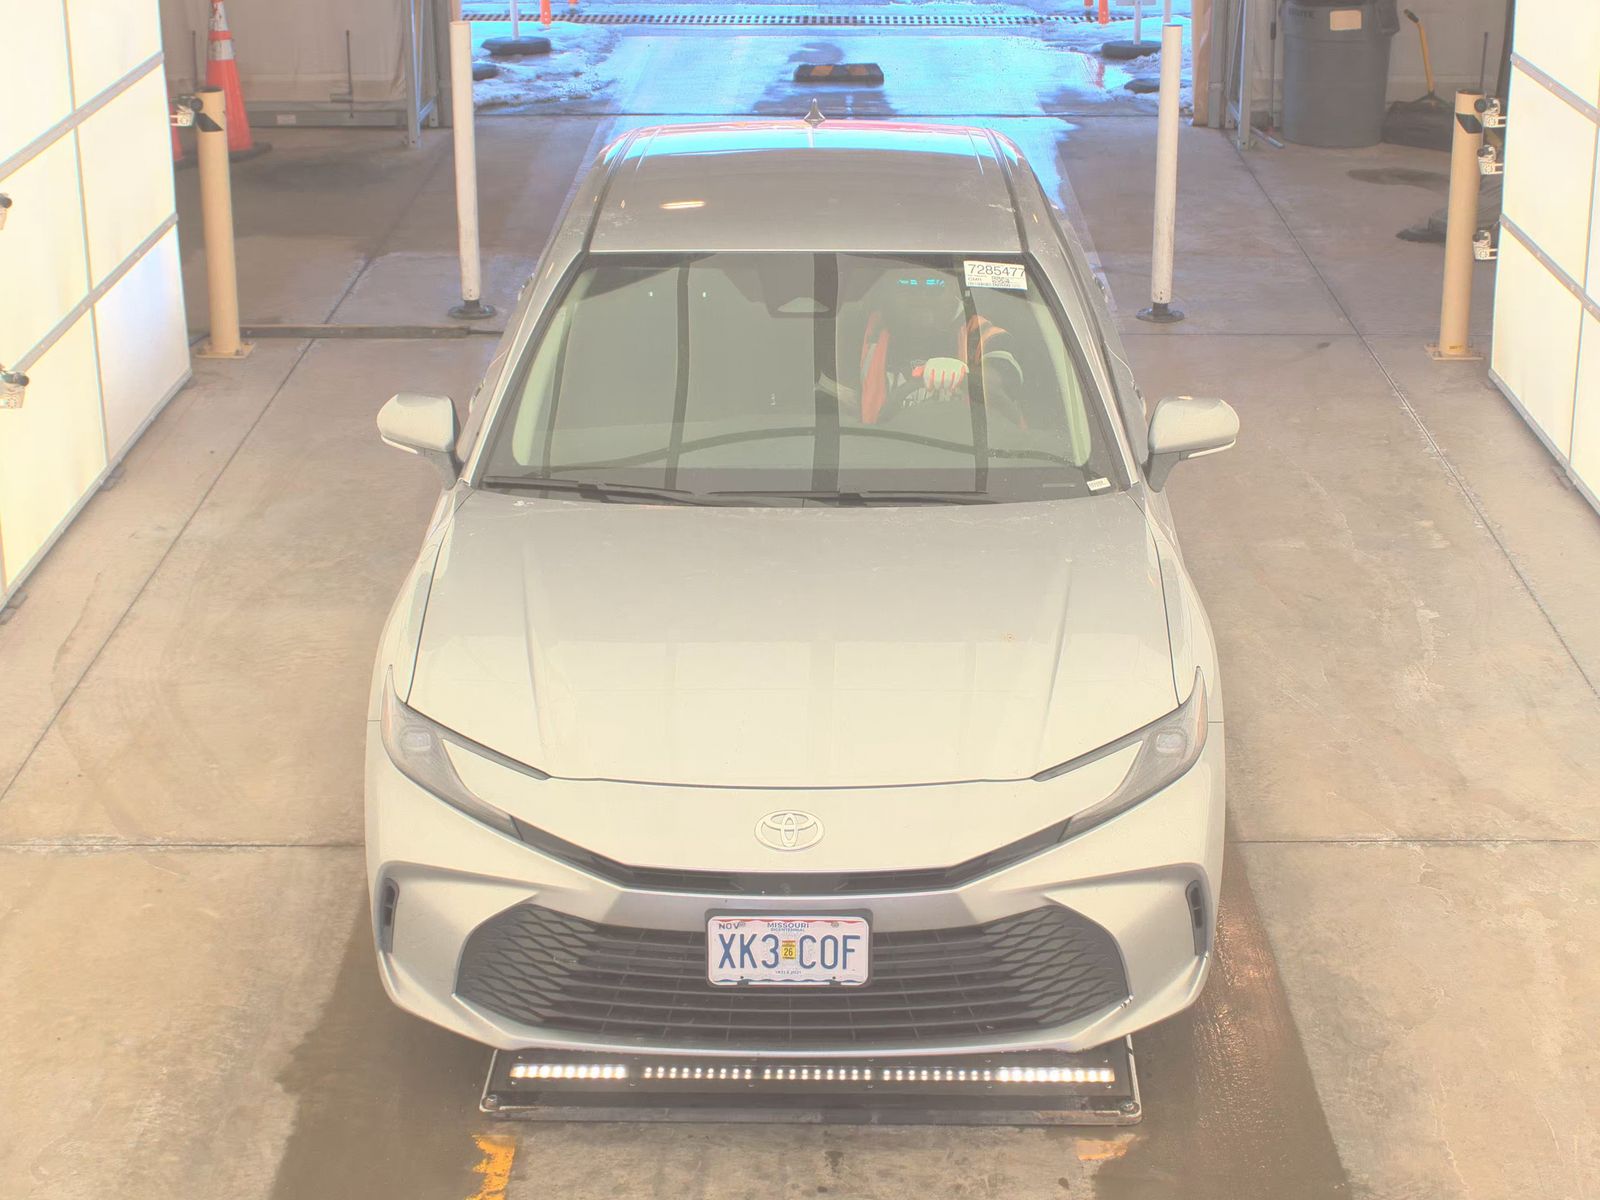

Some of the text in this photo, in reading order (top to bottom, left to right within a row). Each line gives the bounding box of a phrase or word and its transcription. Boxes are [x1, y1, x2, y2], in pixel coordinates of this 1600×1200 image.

[968, 263, 1025, 277] 7285477
[718, 922, 740, 931] NOV
[718, 933, 779, 969] XK3
[783, 947, 794, 957] 26
